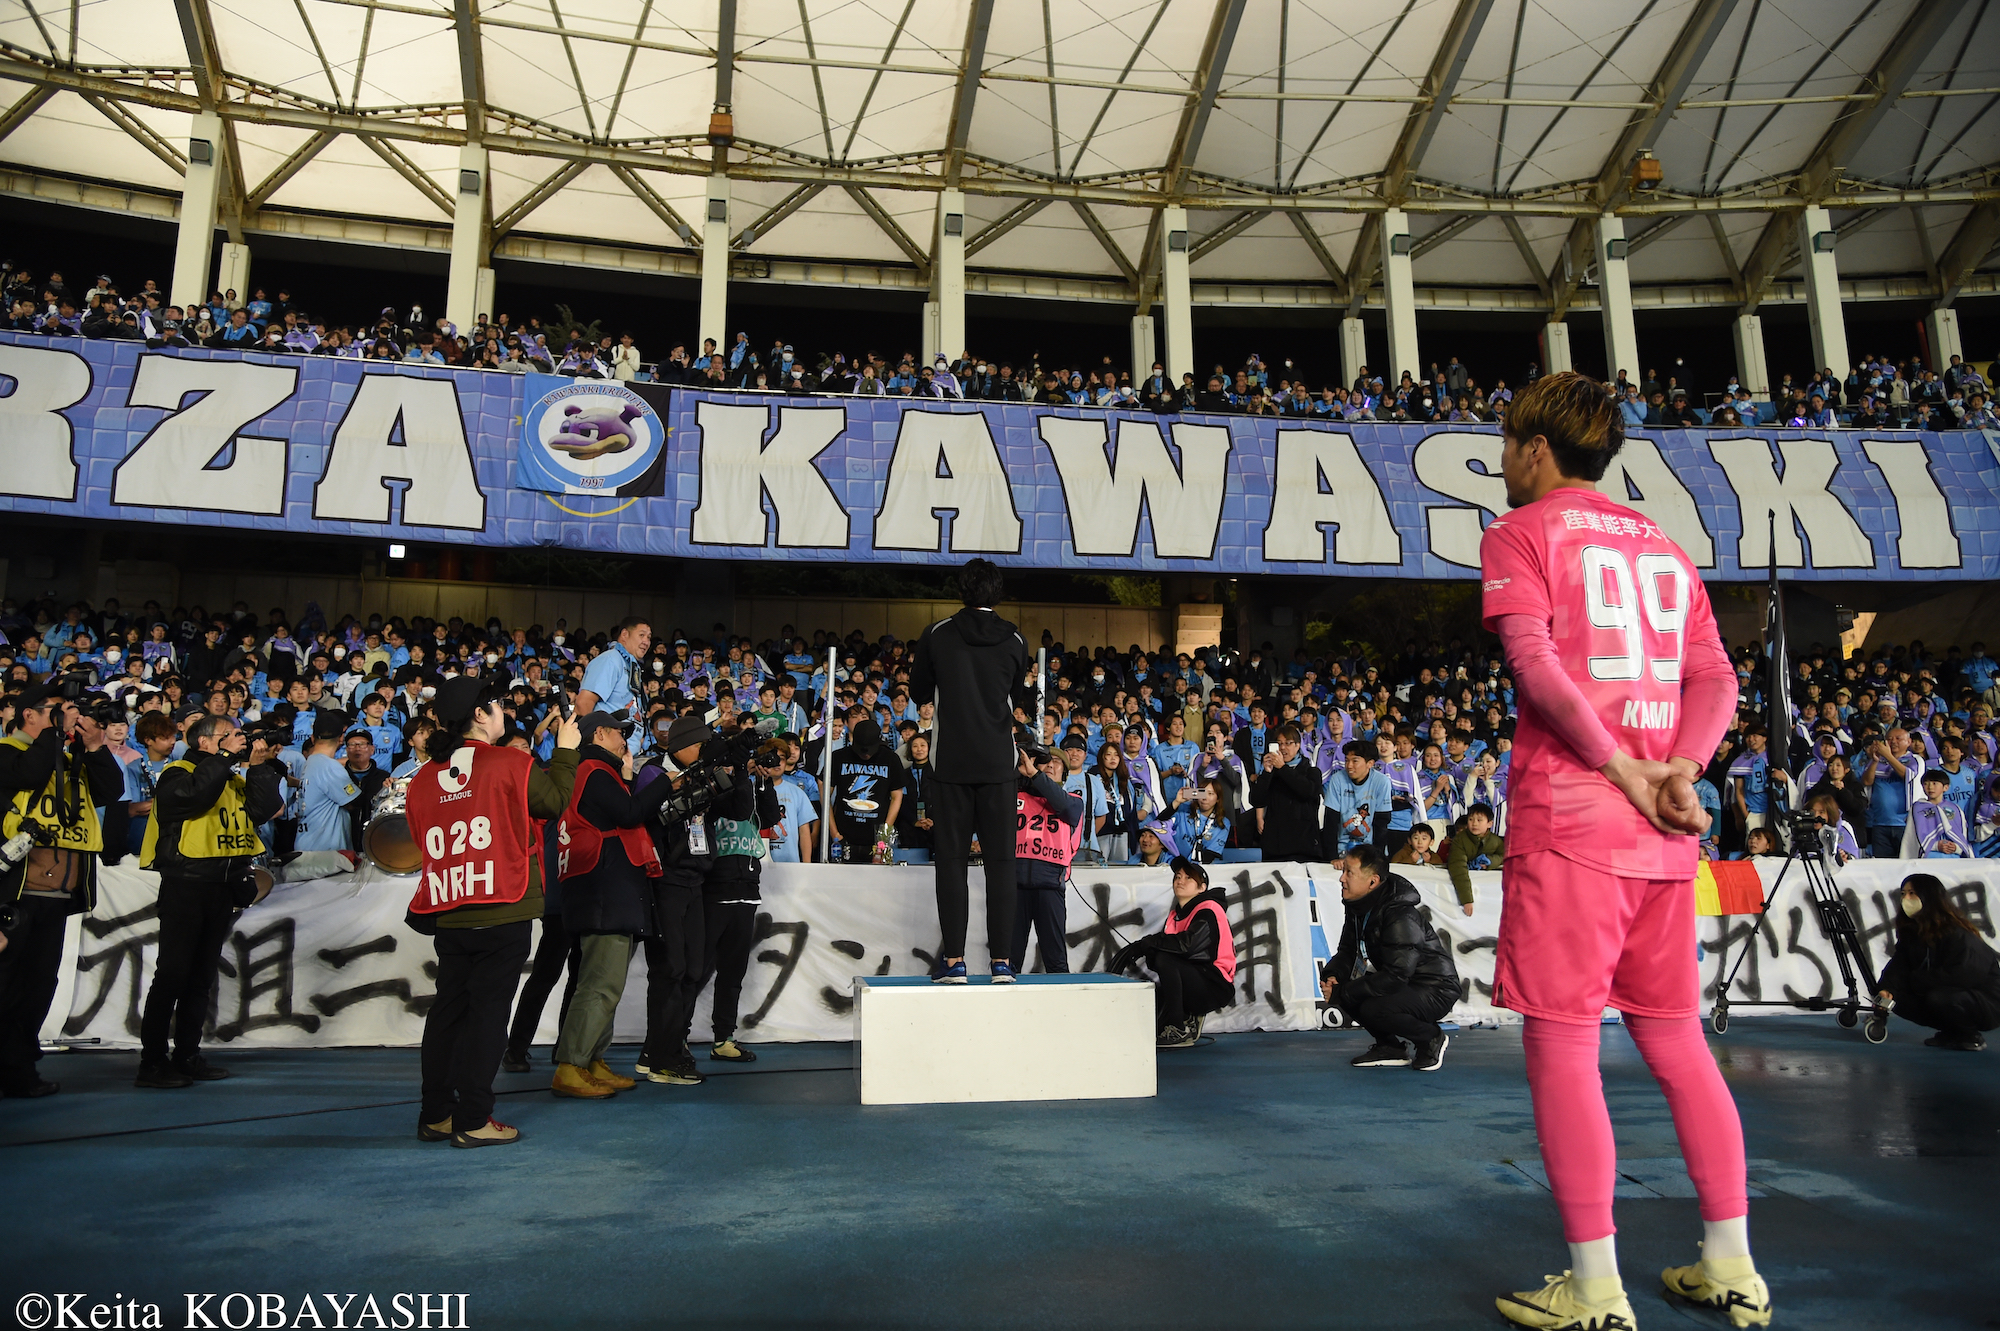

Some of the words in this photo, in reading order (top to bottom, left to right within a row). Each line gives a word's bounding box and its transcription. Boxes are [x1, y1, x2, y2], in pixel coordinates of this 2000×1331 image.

[542, 386, 600, 407] KAWASAKI
[580, 477, 605, 488] 1997
[1581, 544, 1690, 684] 99
[1621, 700, 1675, 729] KAMI
[841, 763, 888, 778] KAWASAKI
[439, 790, 473, 804] J.LEAGUE
[1016, 813, 1059, 833] 025
[217, 833, 255, 850] PRESS
[426, 815, 492, 860] 028
[1032, 837, 1064, 860] Scree
[428, 860, 494, 906] NRH
